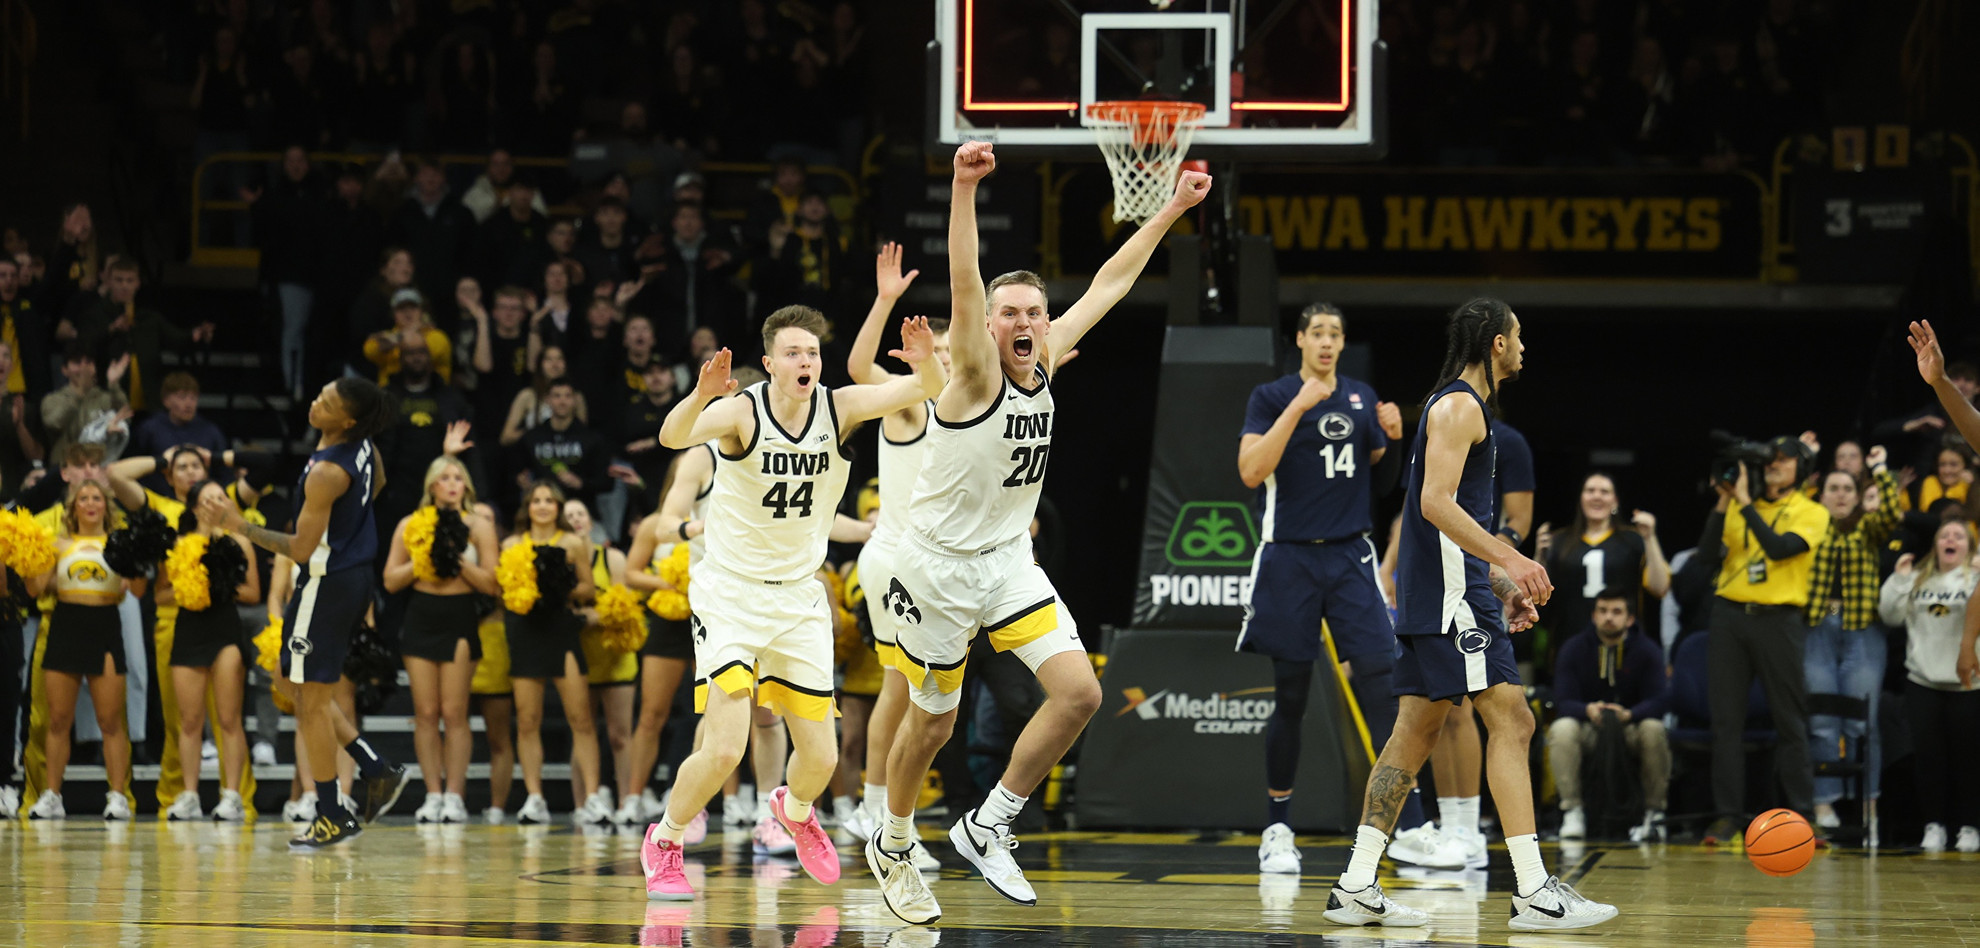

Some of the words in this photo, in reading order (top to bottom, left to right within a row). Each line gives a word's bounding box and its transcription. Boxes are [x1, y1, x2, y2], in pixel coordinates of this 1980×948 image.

[1238, 194, 1369, 249] OWA
[1383, 195, 1722, 250] HAWKEYES
[1824, 198, 1852, 237] 3
[1003, 411, 1052, 440] IOW
[761, 451, 829, 475] IOWA
[1002, 444, 1050, 487] 20
[1319, 443, 1356, 479] 14
[762, 481, 814, 519] 44
[1150, 574, 1252, 606] PIONEE
[1582, 549, 1608, 598] 1
[1164, 692, 1276, 720] Mediaco
[1194, 720, 1267, 734] COURT
